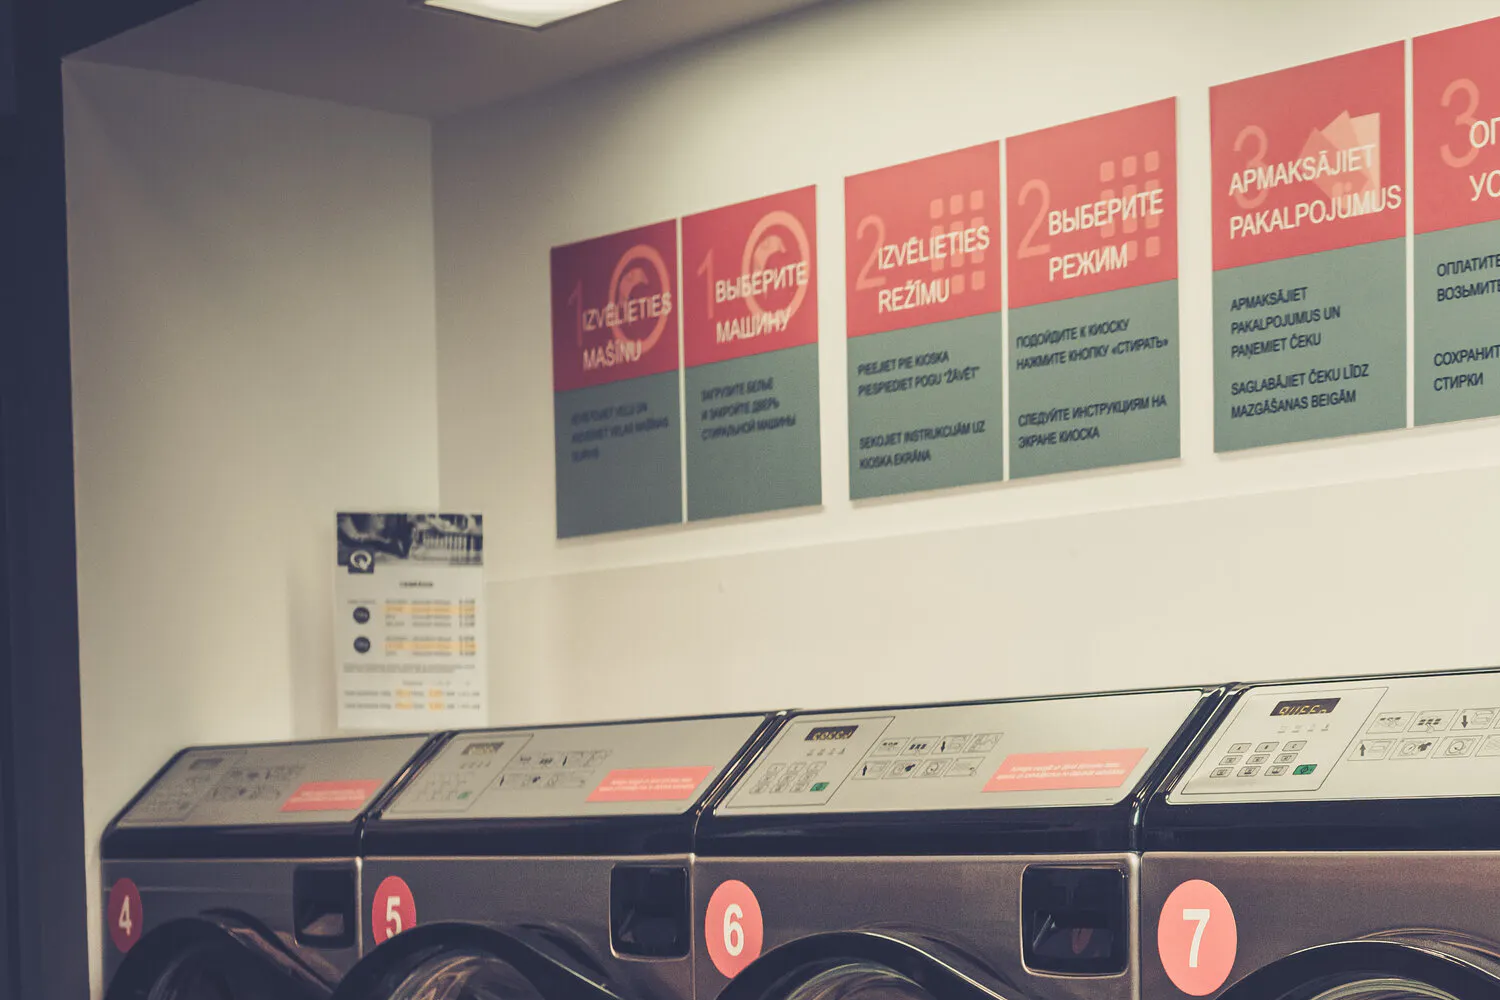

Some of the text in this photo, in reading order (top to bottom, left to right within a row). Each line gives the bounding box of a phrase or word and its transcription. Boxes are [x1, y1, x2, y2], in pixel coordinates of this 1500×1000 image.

[1440, 78, 1480, 168] 3
[1229, 144, 1375, 196] APMAKSĀJIET
[1017, 179, 1050, 260] 2
[1049, 188, 1164, 236] ВЫБЕРИТЕ
[1230, 185, 1402, 240] PAKALPOJUMUS
[856, 214, 887, 291] 2
[878, 225, 990, 270] IZVĒLIETIES
[1049, 243, 1128, 282] РЕЖИМ
[716, 260, 808, 303] ВЫБЕРИТЕ
[879, 278, 949, 314] REŽĪMU
[716, 307, 792, 344] МАШИНУ
[1017, 318, 1130, 349] ПОДОЙДИТЕ К КИОСКУ
[1231, 306, 1341, 334] PAKALPOJUMUS UN
[1017, 350, 1066, 370] НАЖМИТЕ
[1069, 345, 1109, 362] КНОПКУ
[1290, 332, 1321, 350] ČEKU
[1308, 367, 1340, 385] ČEKU
[1434, 372, 1484, 391] СТИРКИ
[973, 420, 986, 434] UZ
[1018, 394, 1167, 428] СЛЕДУЙТЕ ИНСТРУКЦИЯМ НА
[1019, 426, 1100, 448] ЭКРАНЕ КИОСКА
[119, 895, 132, 935] 4
[385, 896, 402, 939] 5
[724, 904, 744, 956] 6
[1183, 909, 1210, 967] 7
